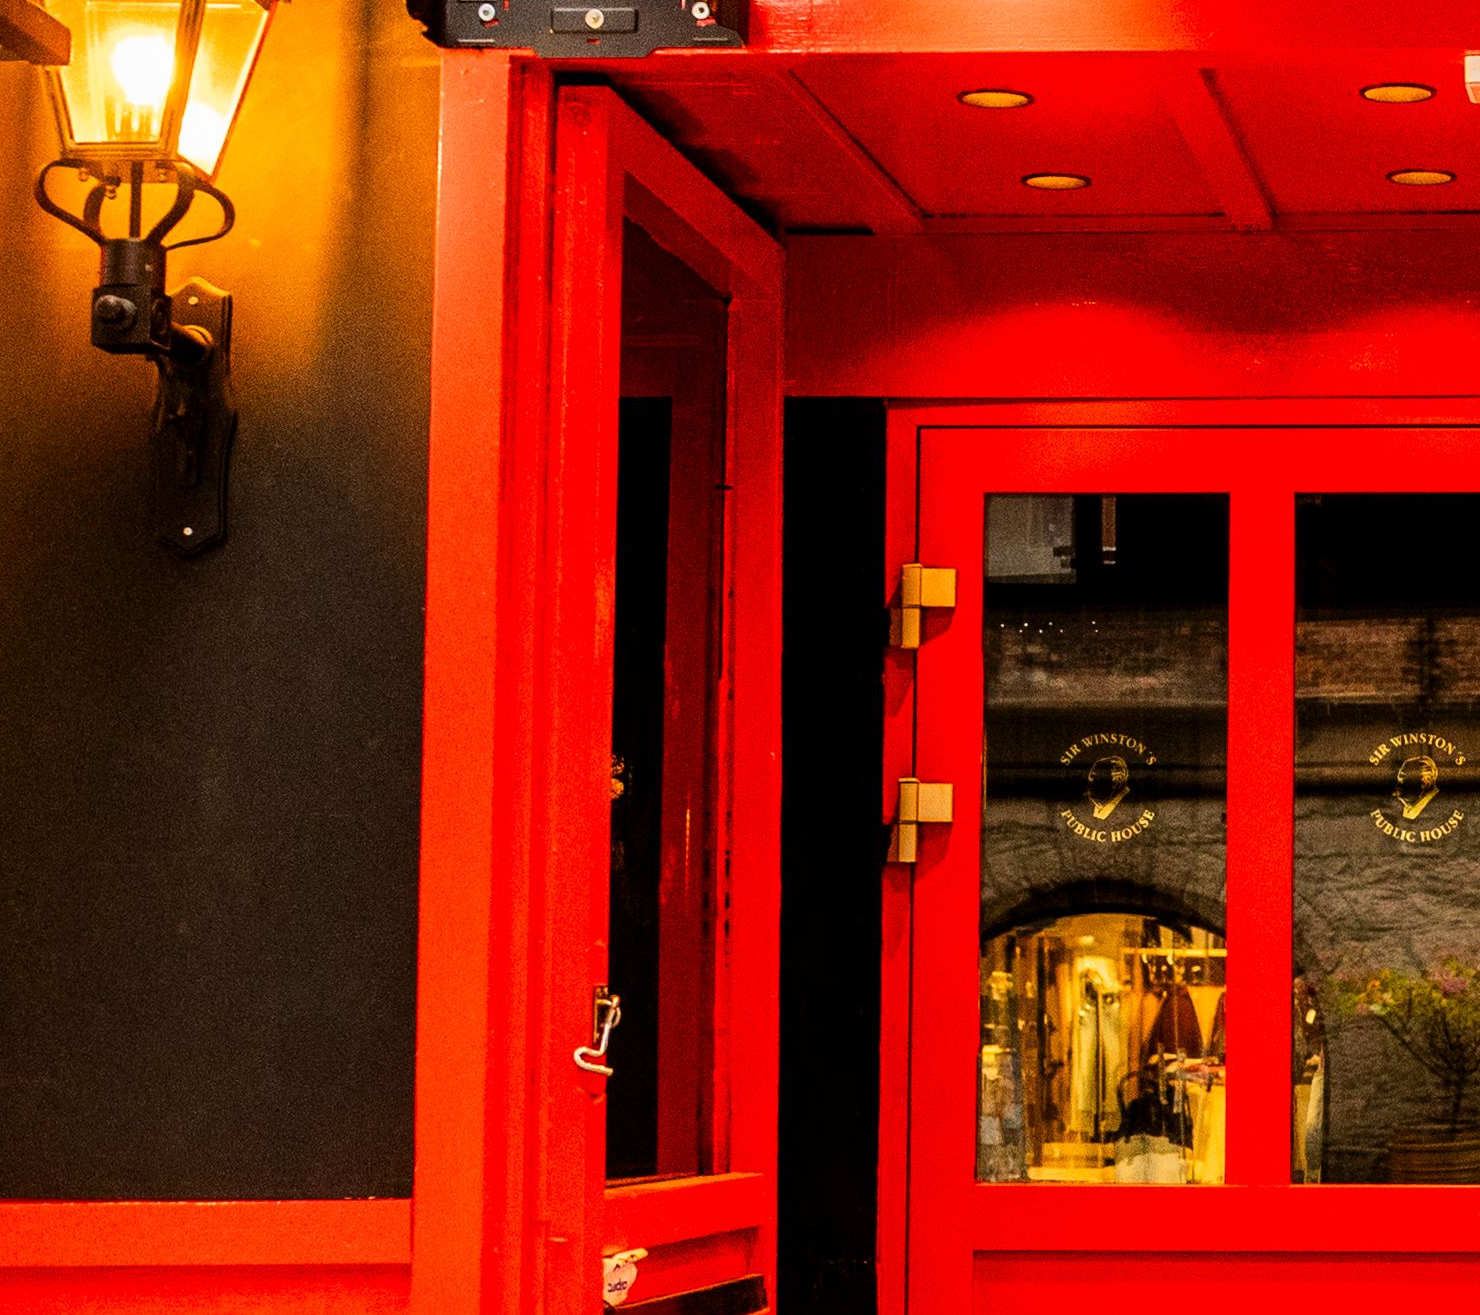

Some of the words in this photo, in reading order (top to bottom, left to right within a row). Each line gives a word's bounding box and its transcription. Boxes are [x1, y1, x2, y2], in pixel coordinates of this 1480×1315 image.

[1060, 744, 1081, 765] SIR
[1369, 744, 1391, 765] SIR
[1061, 809, 1107, 842] PUBLIC
[1110, 809, 1155, 842] HOUSE
[1370, 809, 1416, 842] PUBLIC
[1420, 809, 1464, 842] HOUSE
